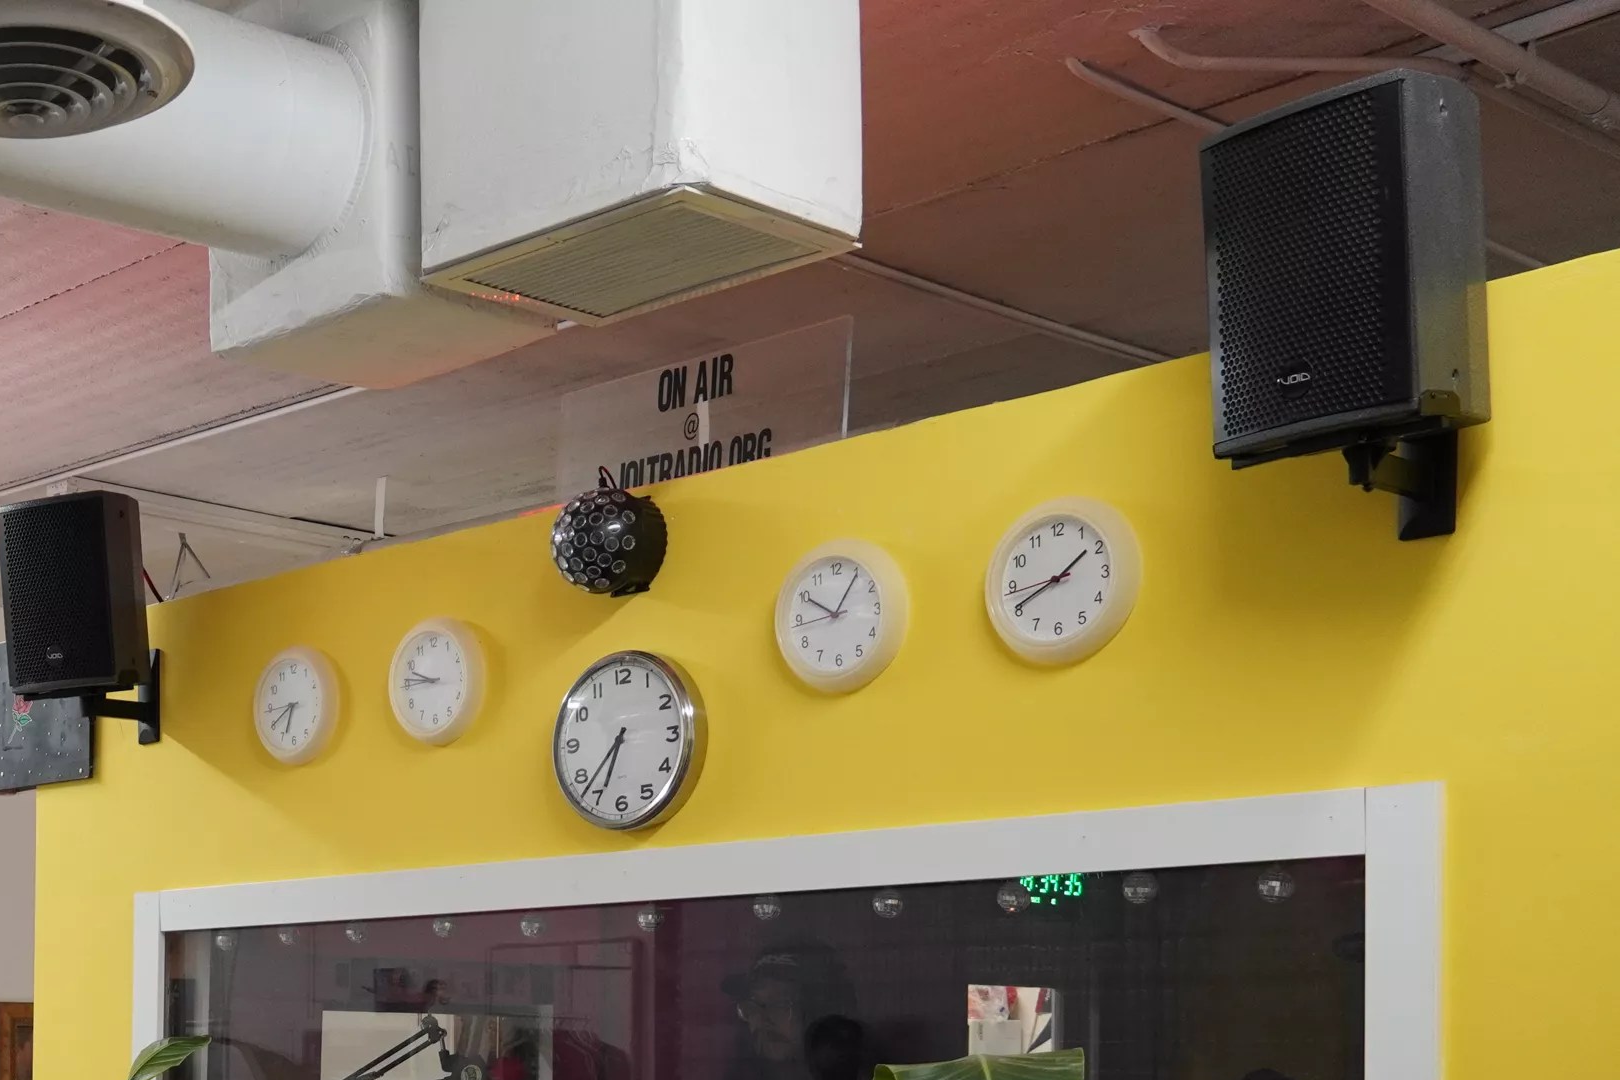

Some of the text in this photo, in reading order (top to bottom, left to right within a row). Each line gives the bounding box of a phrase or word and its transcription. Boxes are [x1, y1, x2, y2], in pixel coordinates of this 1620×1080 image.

[658, 353, 734, 412] ON AIR
[684, 412, 699, 440] @
[1051, 523, 1064, 536] 12
[1030, 535, 1040, 548] 11
[1095, 540, 1103, 554] 2
[1013, 554, 1026, 568] 10
[830, 563, 842, 575] 12
[1101, 564, 1109, 578] 3
[812, 573, 822, 586] 11
[868, 581, 876, 593] 2
[1009, 580, 1016, 593] 9
[799, 591, 810, 603] 10
[1094, 591, 1102, 604] 4
[874, 603, 880, 615] 3
[1015, 604, 1023, 617] 8
[796, 615, 803, 626] 9
[1078, 611, 1087, 624] 5
[1032, 618, 1040, 631] 7
[1054, 622, 1062, 635] 6
[869, 627, 876, 638] 4
[430, 637, 437, 647] 12
[802, 636, 808, 648] 8
[416, 645, 424, 656] 11
[817, 650, 823, 662] 7
[856, 645, 863, 657] 5
[408, 660, 415, 670] 10
[835, 654, 842, 666] 6
[615, 669, 631, 685] 12
[593, 683, 602, 698] 11
[409, 698, 414, 709] 8
[659, 694, 672, 710] 2
[420, 710, 424, 720] 7
[447, 706, 452, 717] 5
[576, 707, 588, 722] 10
[433, 714, 438, 724] 6
[666, 725, 679, 742] 3
[566, 739, 580, 753] 9
[659, 758, 671, 773] 4
[575, 769, 588, 783] 8
[592, 790, 603, 805] 7
[640, 784, 653, 800] 5
[615, 796, 628, 812] 6
